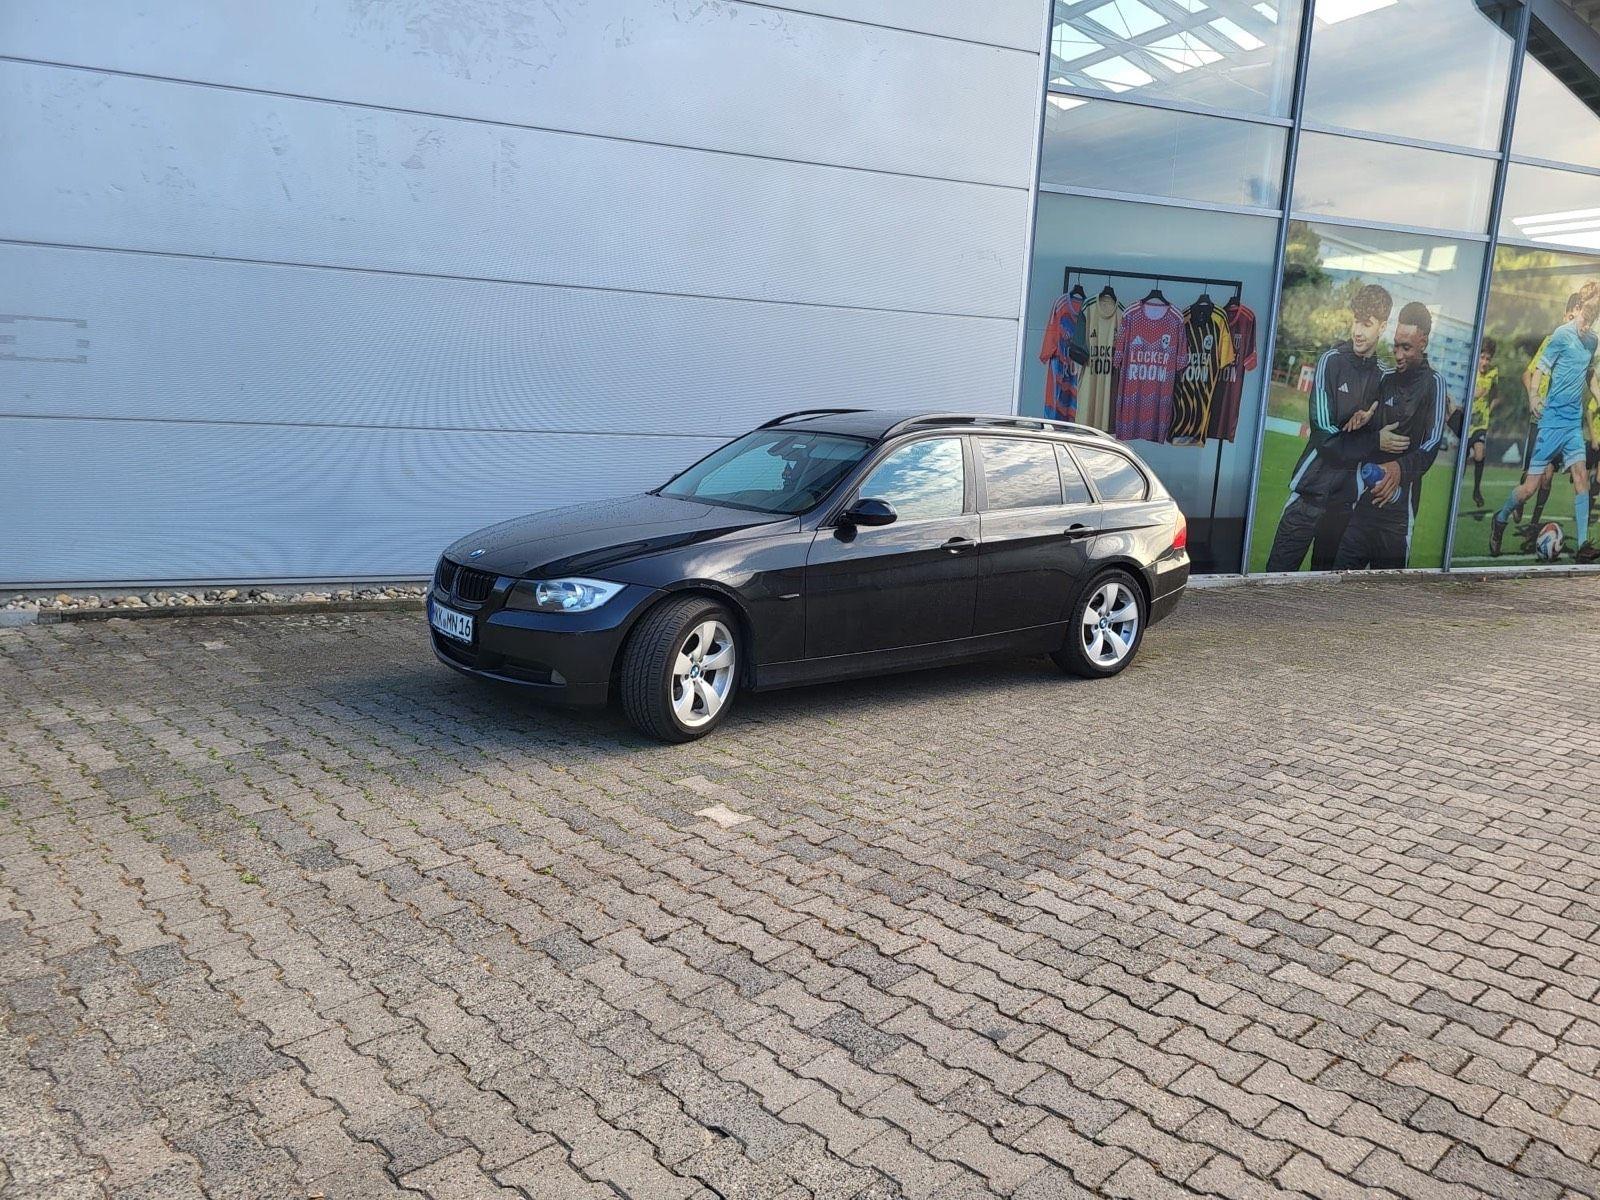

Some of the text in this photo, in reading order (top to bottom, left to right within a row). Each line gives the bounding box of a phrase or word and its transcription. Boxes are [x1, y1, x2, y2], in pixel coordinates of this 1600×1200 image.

[1130, 350, 1169, 365] LOCKER
[1128, 364, 1167, 382] ROOM
[459, 617, 471, 637] 16
